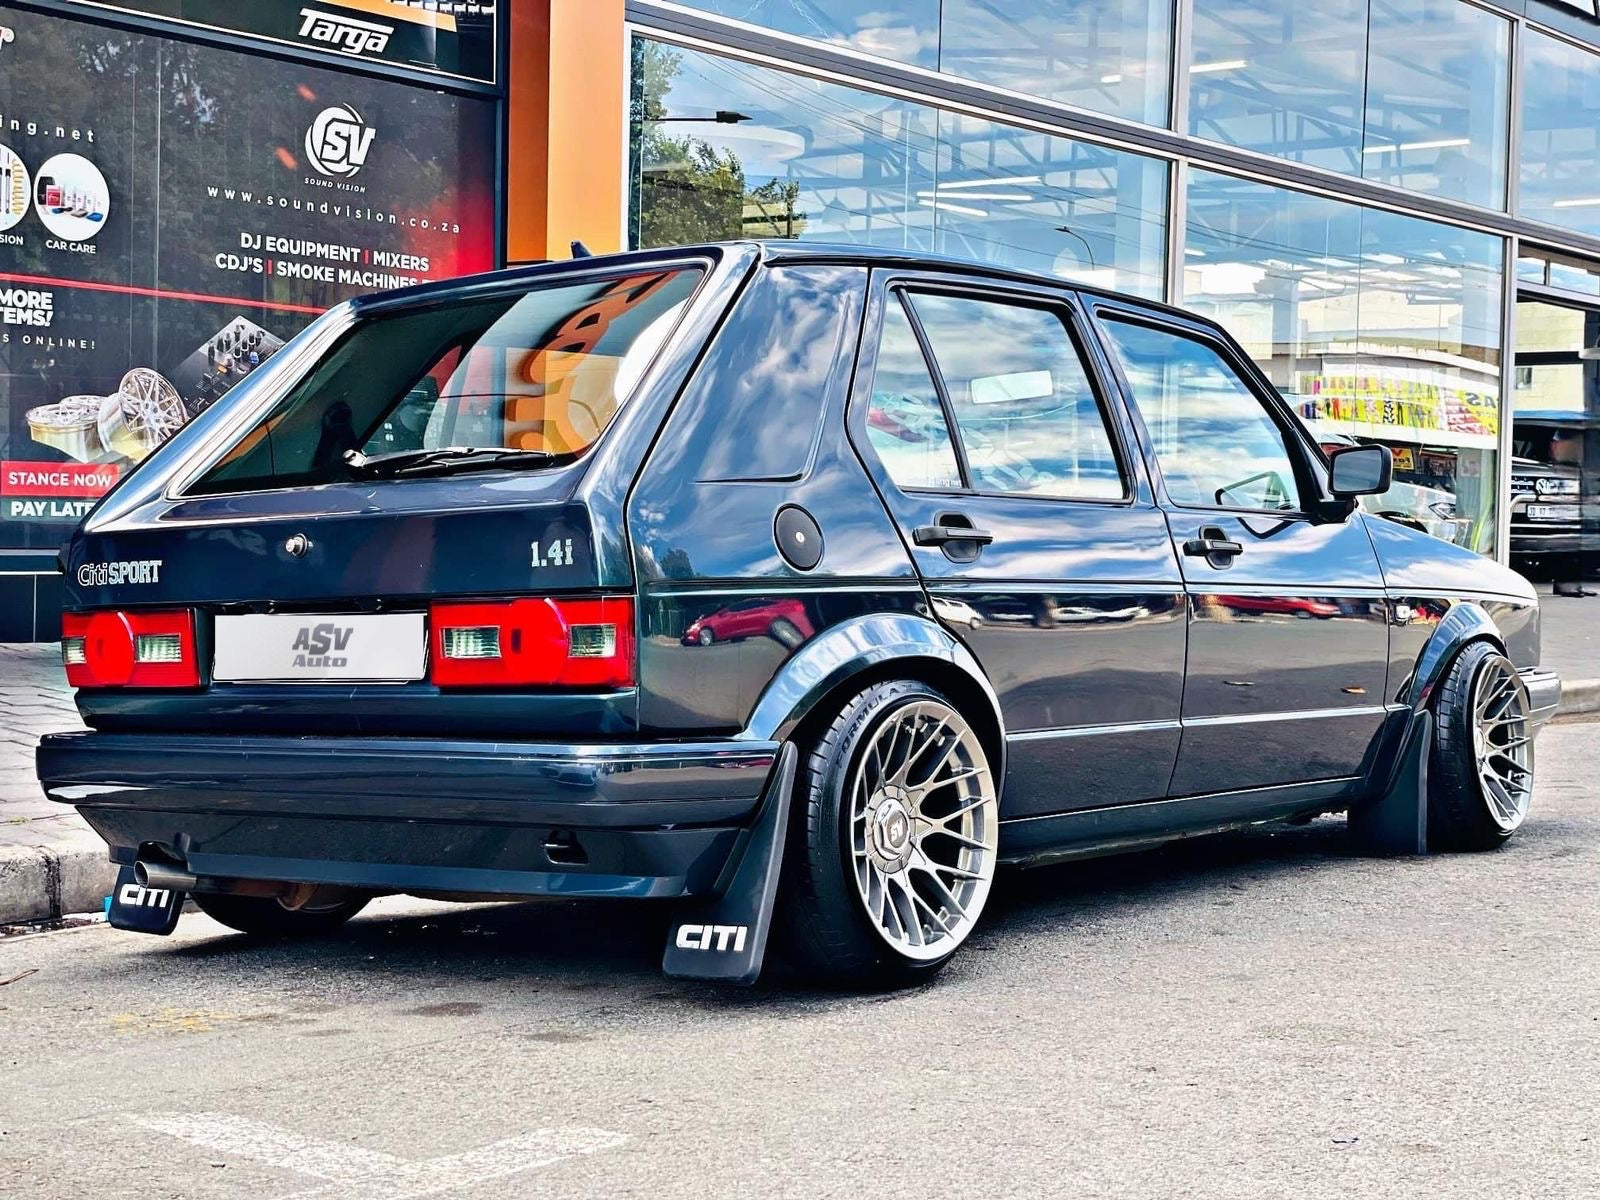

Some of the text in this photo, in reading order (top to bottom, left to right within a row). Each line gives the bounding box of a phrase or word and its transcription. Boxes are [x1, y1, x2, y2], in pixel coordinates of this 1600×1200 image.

[298, 7, 395, 54] Targa
[304, 177, 366, 193] SOUND VISION
[207, 186, 460, 233] www.soundvision.co.za
[45, 239, 97, 254] CAR CARE
[240, 232, 430, 272] DJ EQUIPMENT MIXERS
[215, 252, 264, 274] CDJ'S
[276, 260, 335, 282] SMOKE
[0, 288, 53, 310] MORE
[22, 335, 95, 350] ONLINE!
[8, 471, 113, 488] STANCE NOW
[10, 501, 47, 517] PAY
[531, 538, 574, 567] 1.4i
[291, 623, 354, 656] ASV
[291, 654, 348, 668] Auto
[835, 686, 901, 769] FORMULA
[119, 883, 170, 908] CITI
[675, 924, 748, 952] CITI
